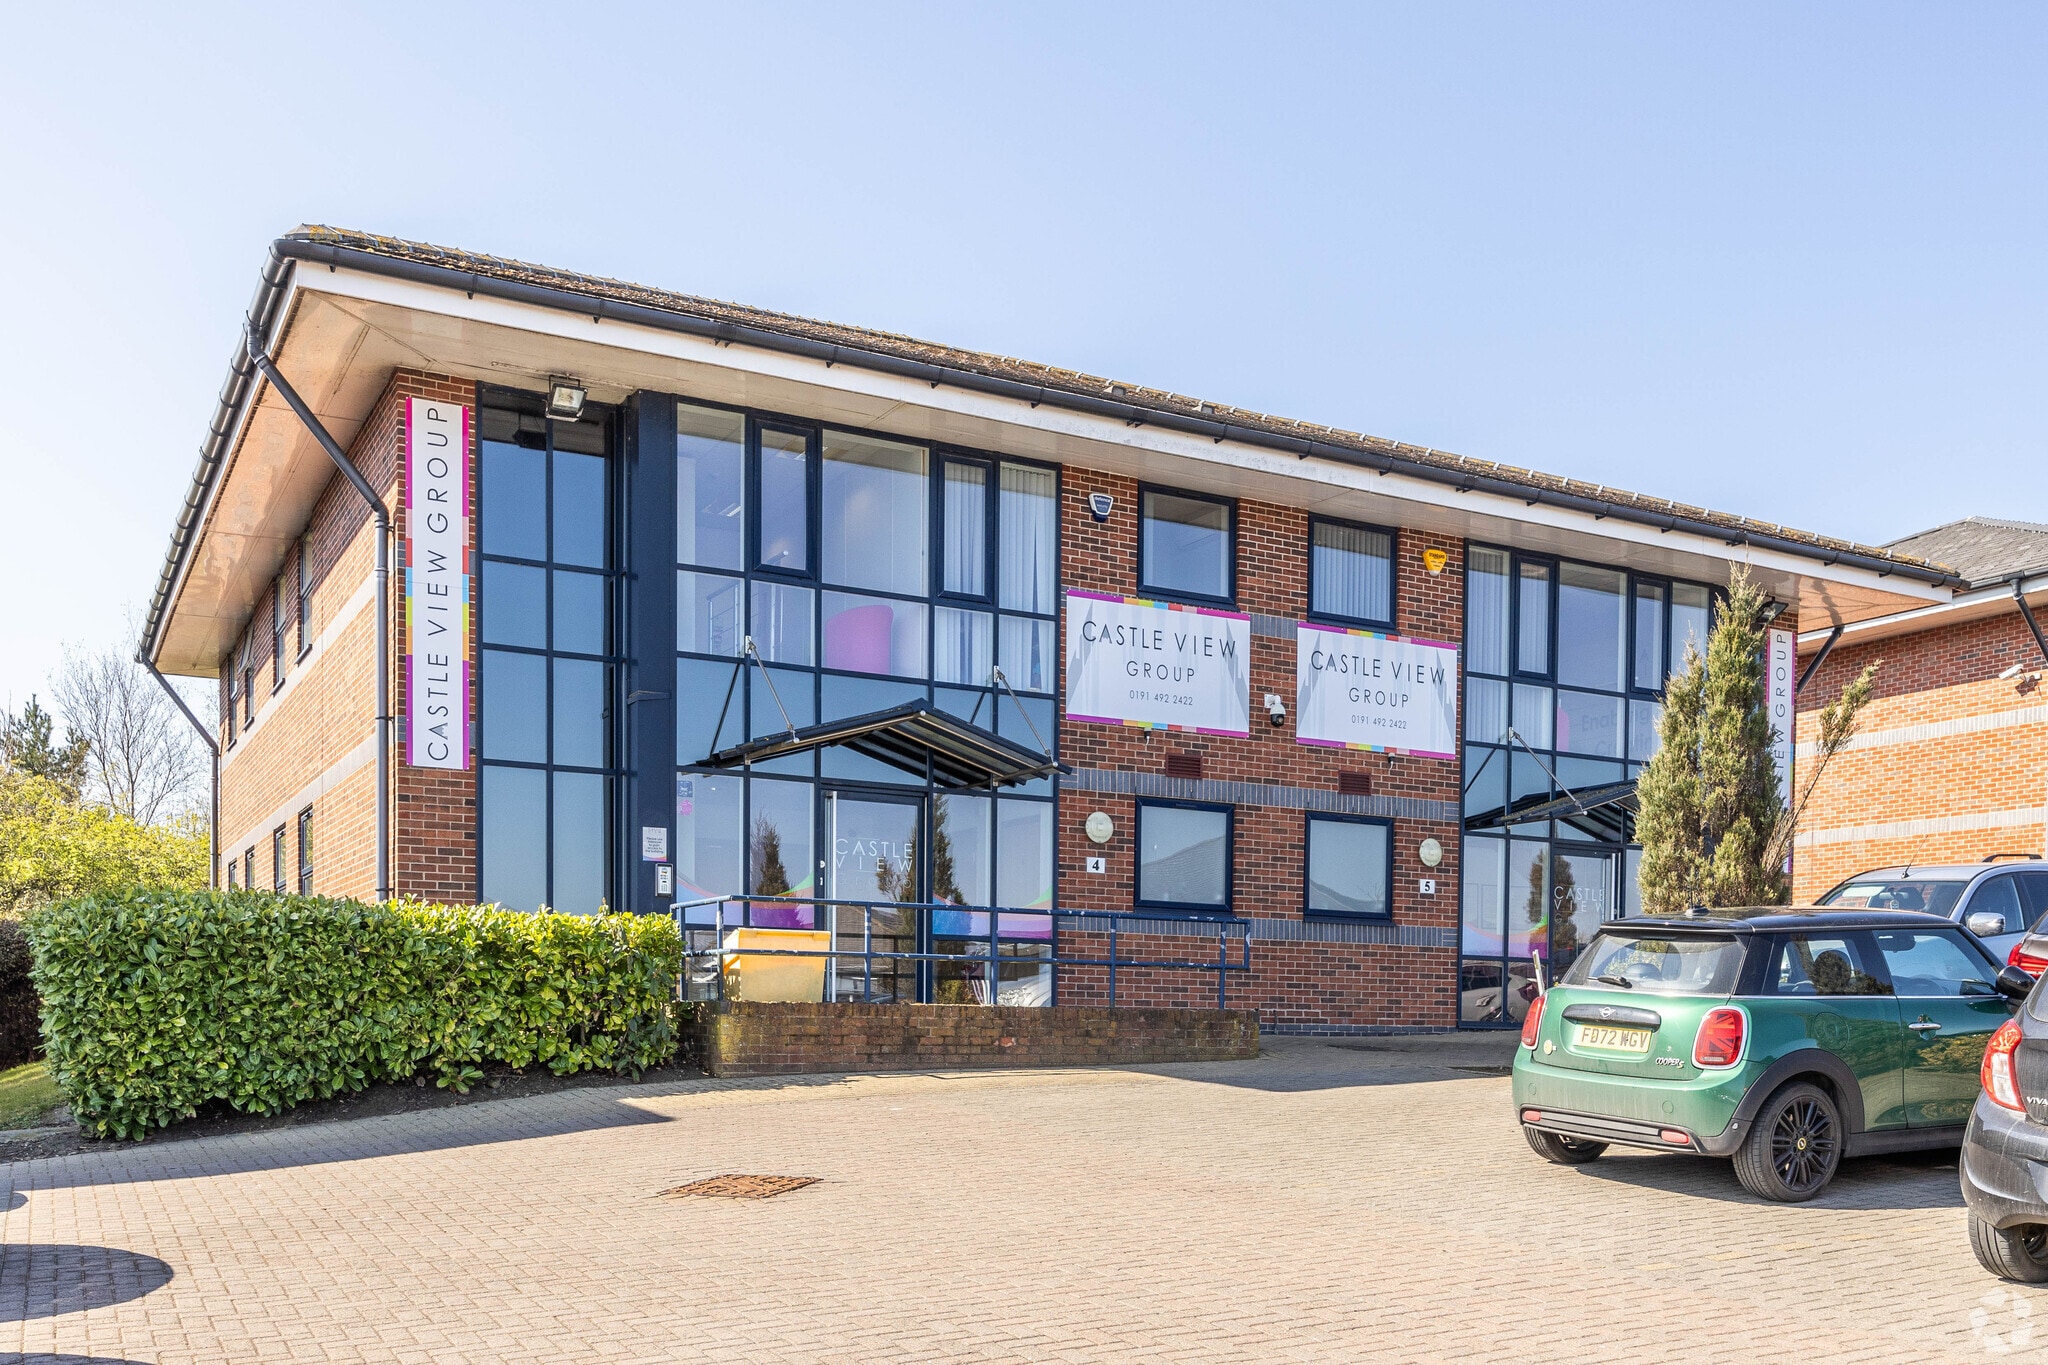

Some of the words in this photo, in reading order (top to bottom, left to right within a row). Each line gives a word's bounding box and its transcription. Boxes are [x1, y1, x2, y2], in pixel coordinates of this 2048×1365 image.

[427, 407, 449, 534] GROUP
[427, 549, 449, 637] VIEW
[1082, 620, 1163, 651] CASTLE
[1174, 632, 1236, 658] VIEW
[1126, 660, 1195, 683] GROUP
[1311, 650, 1381, 678] CASTLE
[1391, 661, 1445, 686] VIEW
[1775, 633, 1787, 718] GROUP
[427, 653, 449, 761] CASTLE
[1129, 690, 1150, 701] 0191
[1154, 693, 1169, 704] 492
[1173, 694, 1193, 706] 2422
[1348, 687, 1409, 708] GROUP
[1351, 714, 1369, 724] 0191
[1373, 717, 1387, 727] 492
[1389, 719, 1407, 730] 2422
[1774, 728, 1785, 769] IEW
[836, 838, 913, 859] CASTLE
[836, 855, 913, 873] VIEW
[1092, 859, 1100, 871] 4
[1424, 881, 1431, 892] 5
[1553, 885, 1605, 902] CASTLE
[1553, 899, 1605, 913] VIEW
[1581, 1027, 1617, 1046] FD72
[1619, 1031, 1649, 1049] WGV
